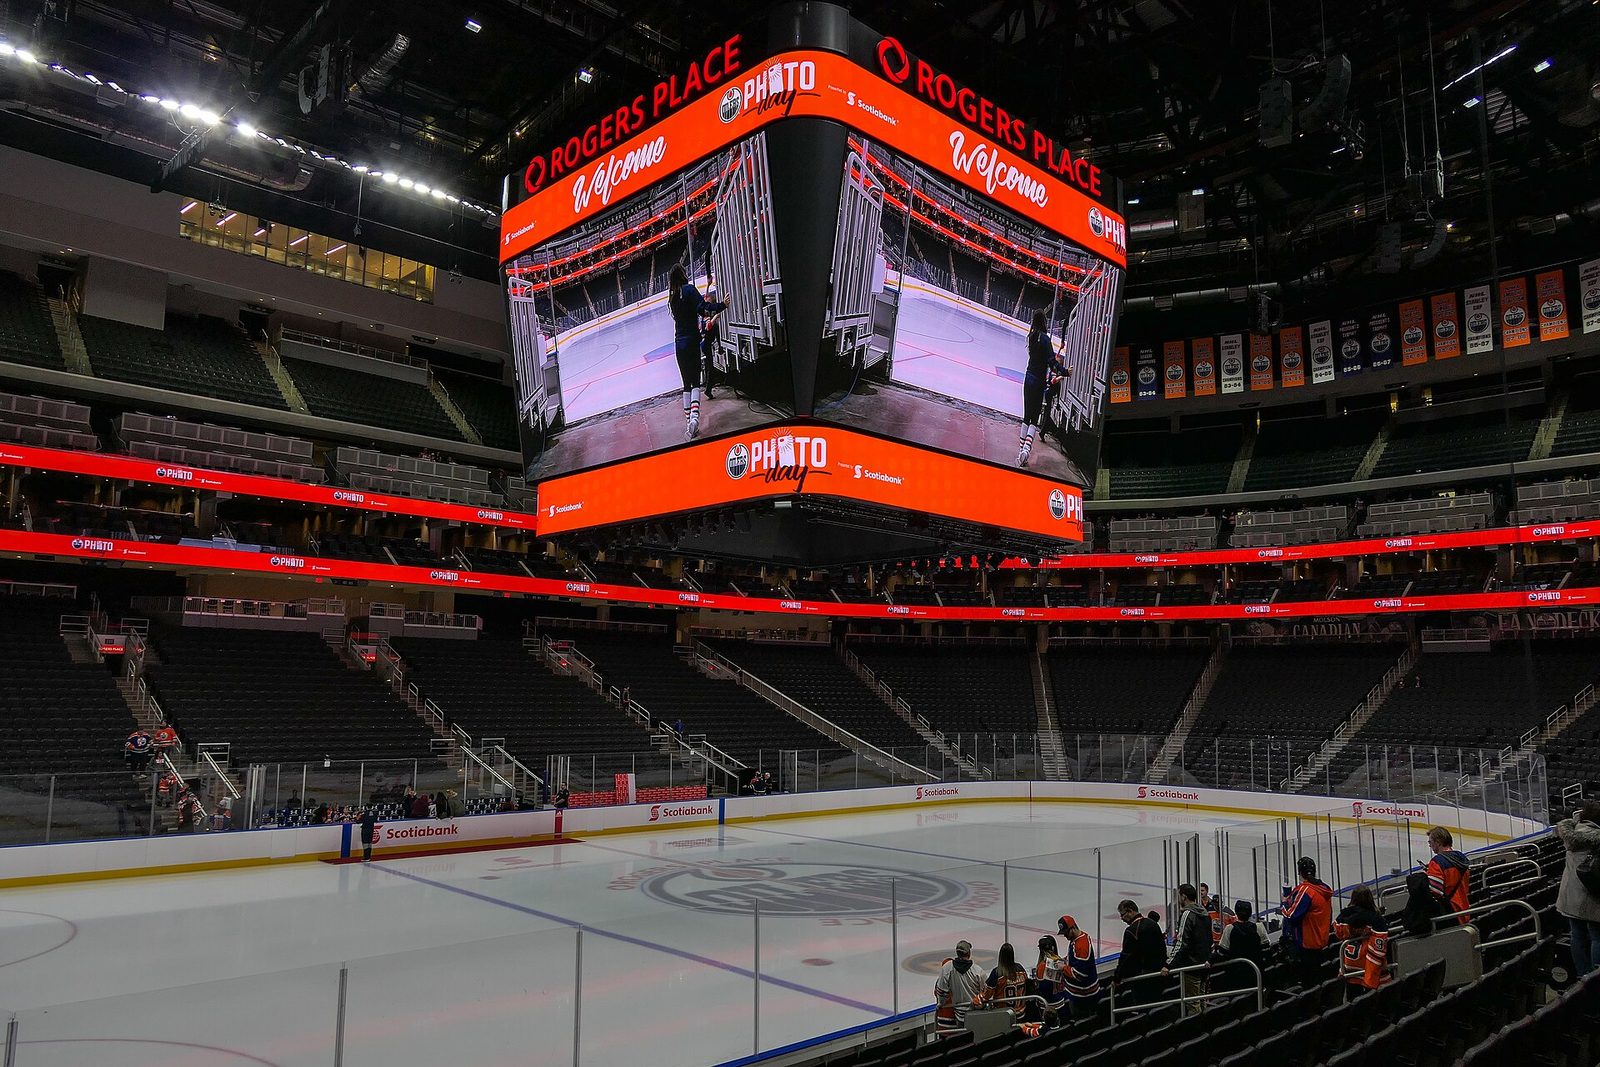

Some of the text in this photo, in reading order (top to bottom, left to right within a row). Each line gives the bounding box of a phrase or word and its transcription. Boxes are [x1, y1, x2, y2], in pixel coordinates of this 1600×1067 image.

[549, 33, 743, 179] ROGERS PLACE
[857, 98, 897, 126] Scotiabank
[916, 58, 1102, 197] ROGERS PLACE
[572, 136, 668, 214] Welcome
[949, 130, 1048, 209] Welcome
[764, 460, 809, 493] day
[864, 469, 902, 485] Scotiabank
[923, 787, 959, 798] Scotiabank
[1149, 788, 1199, 801] Scotiabank
[663, 804, 713, 818] Scotiabank
[1366, 805, 1426, 819] Scotiabank
[386, 823, 459, 841] Scotiabank
